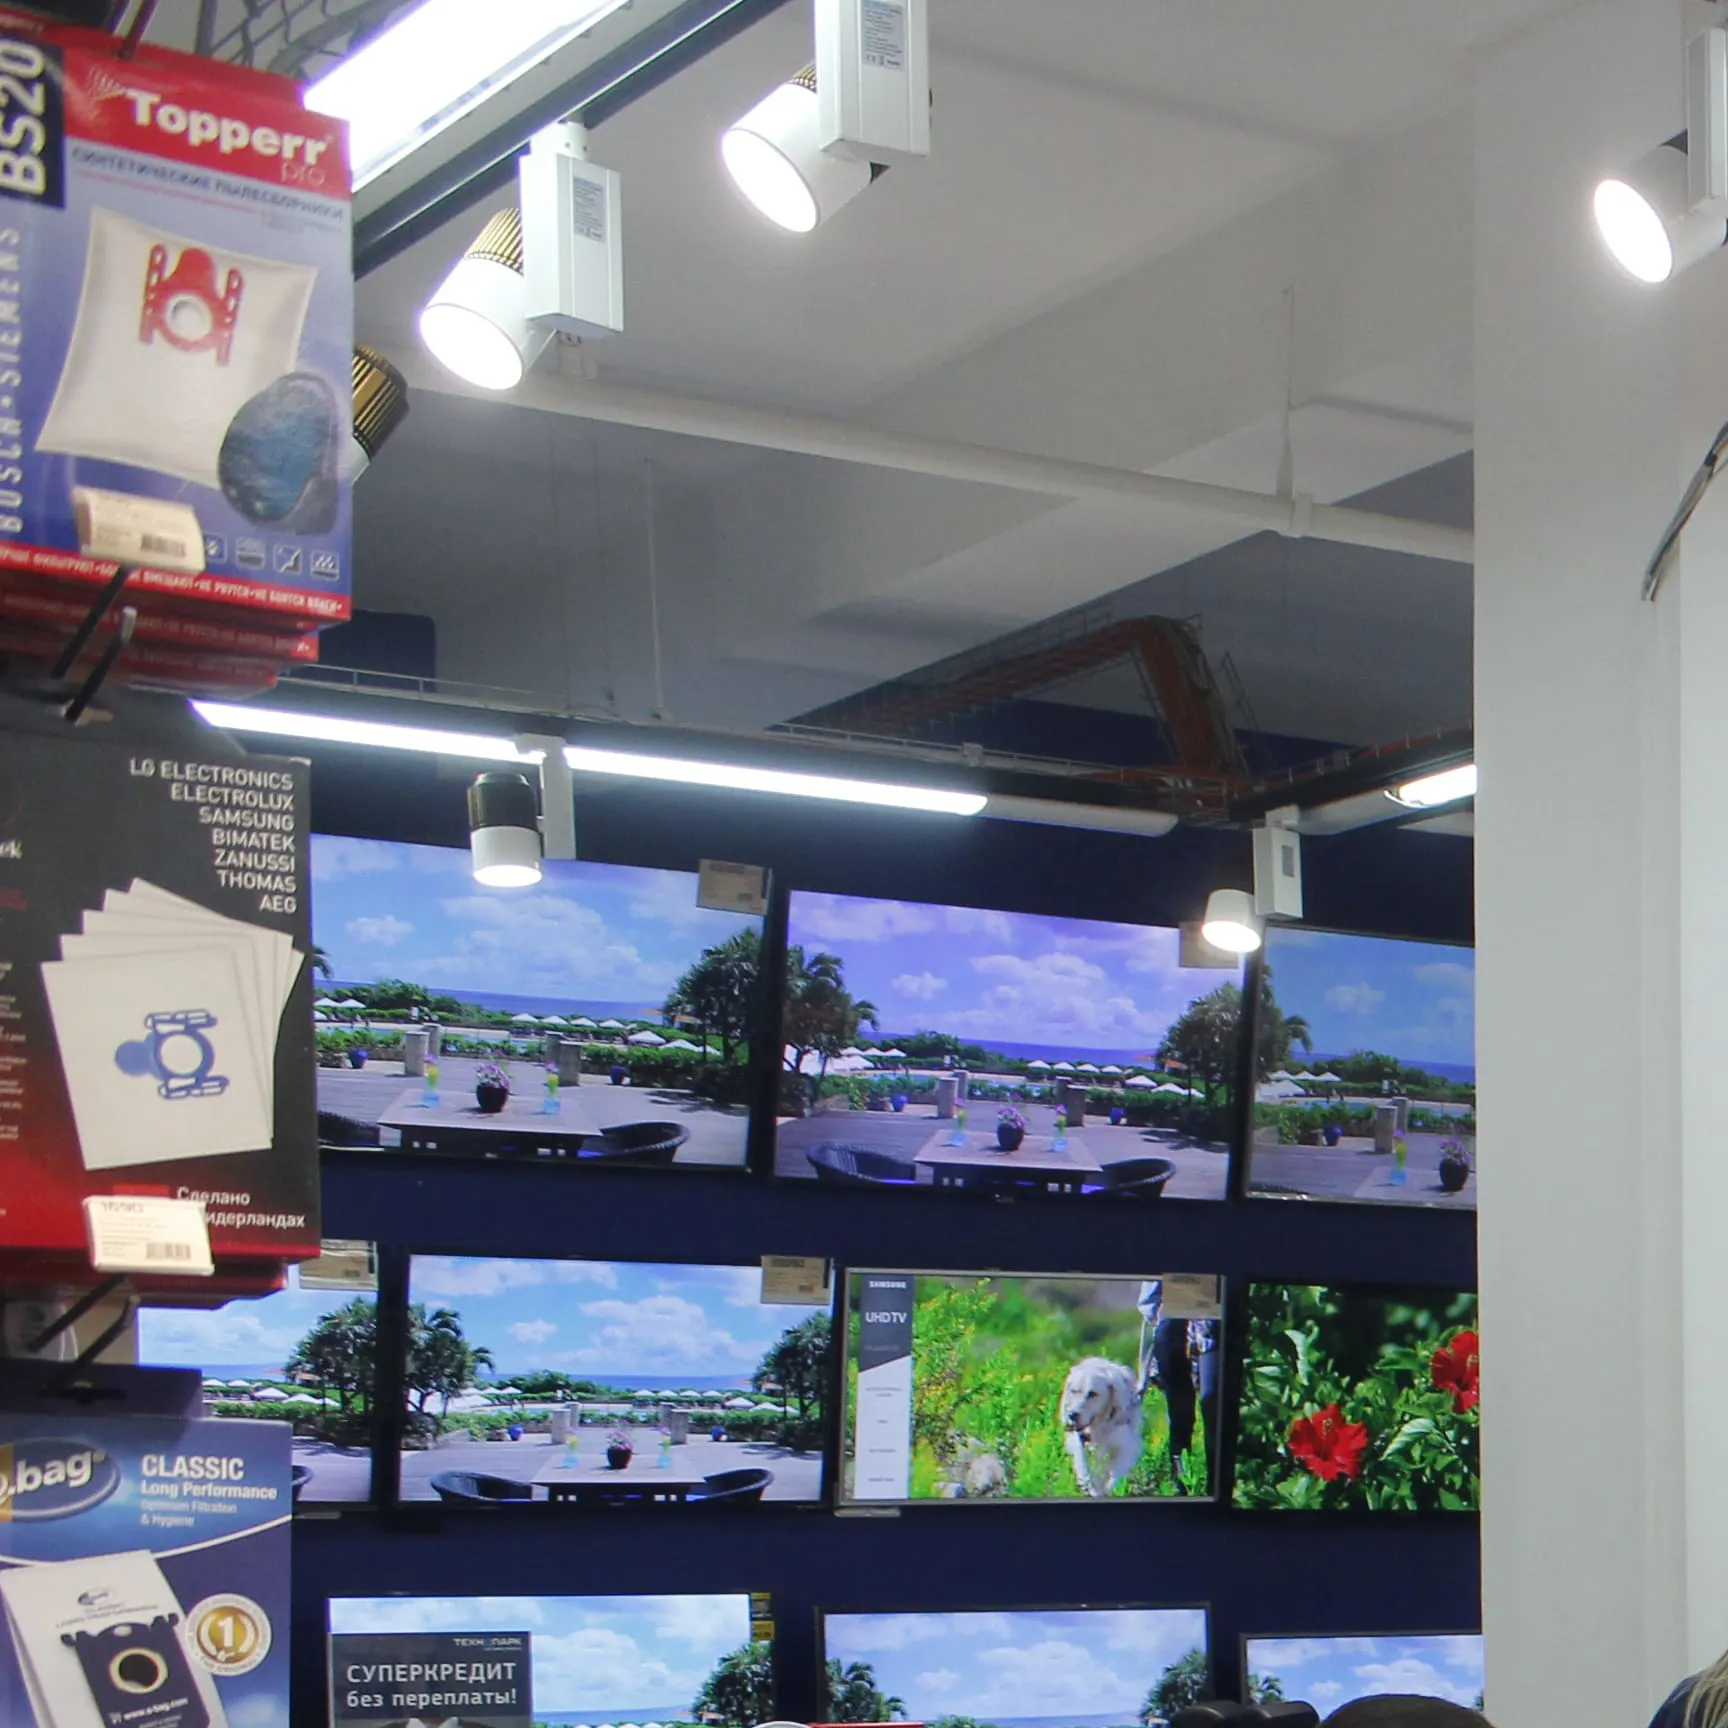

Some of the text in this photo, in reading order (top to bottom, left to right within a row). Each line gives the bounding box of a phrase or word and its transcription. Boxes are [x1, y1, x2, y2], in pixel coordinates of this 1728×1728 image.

[126, 87, 328, 166] Topperr
[280, 161, 327, 185] pro
[130, 757, 294, 791] LG ELECTRONICS
[170, 782, 294, 812] ELECTROLUX
[199, 806, 295, 832] SAMSUNG
[212, 827, 296, 852] BIMATEK
[214, 849, 296, 873] ZANUSSI
[216, 869, 297, 893] THOMAS
[259, 894, 297, 914] AEG
[176, 1186, 251, 1206] Сделано
[205, 1210, 306, 1230] идерландах
[141, 1454, 244, 1481] CLASSIC
[140, 1480, 278, 1500] Long Performance
[347, 1662, 516, 1684] СУПЕРКРЕДИТ
[347, 1688, 517, 1710] без переплаты!
